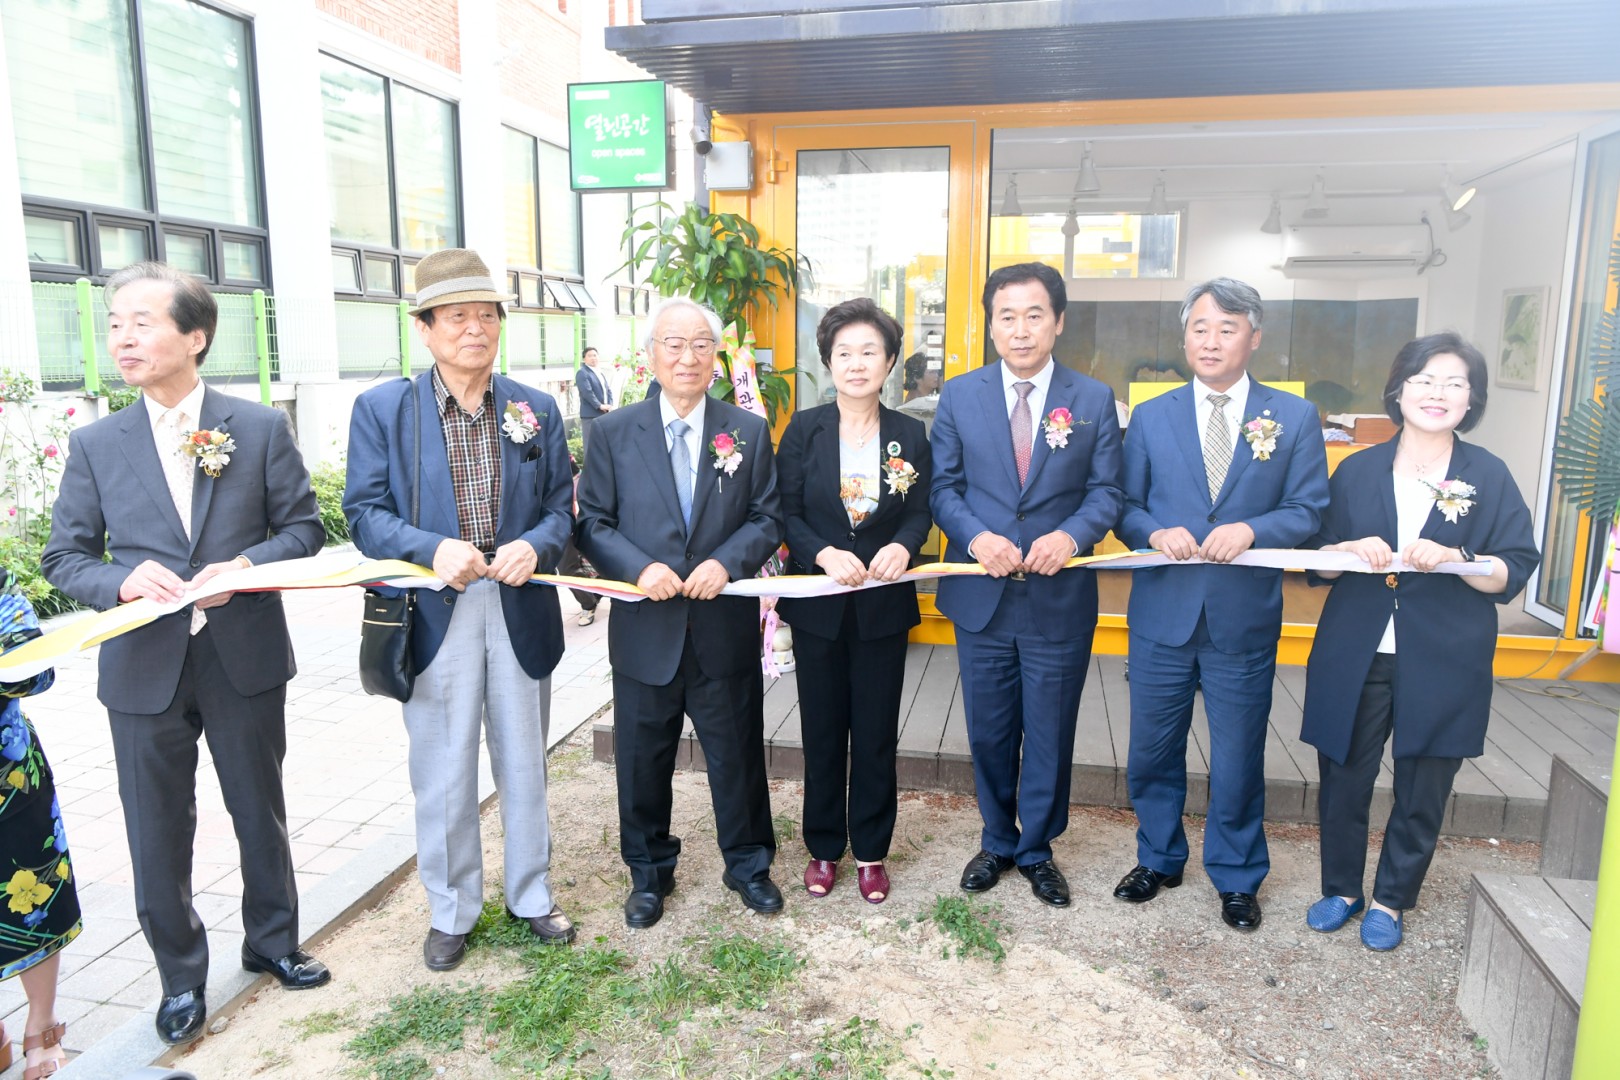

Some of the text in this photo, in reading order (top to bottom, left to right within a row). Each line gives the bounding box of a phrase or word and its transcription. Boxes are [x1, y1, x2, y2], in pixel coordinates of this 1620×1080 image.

[584, 113, 651, 142] 열린공간
[591, 149, 613, 159] open
[736, 371, 754, 410] 개관
